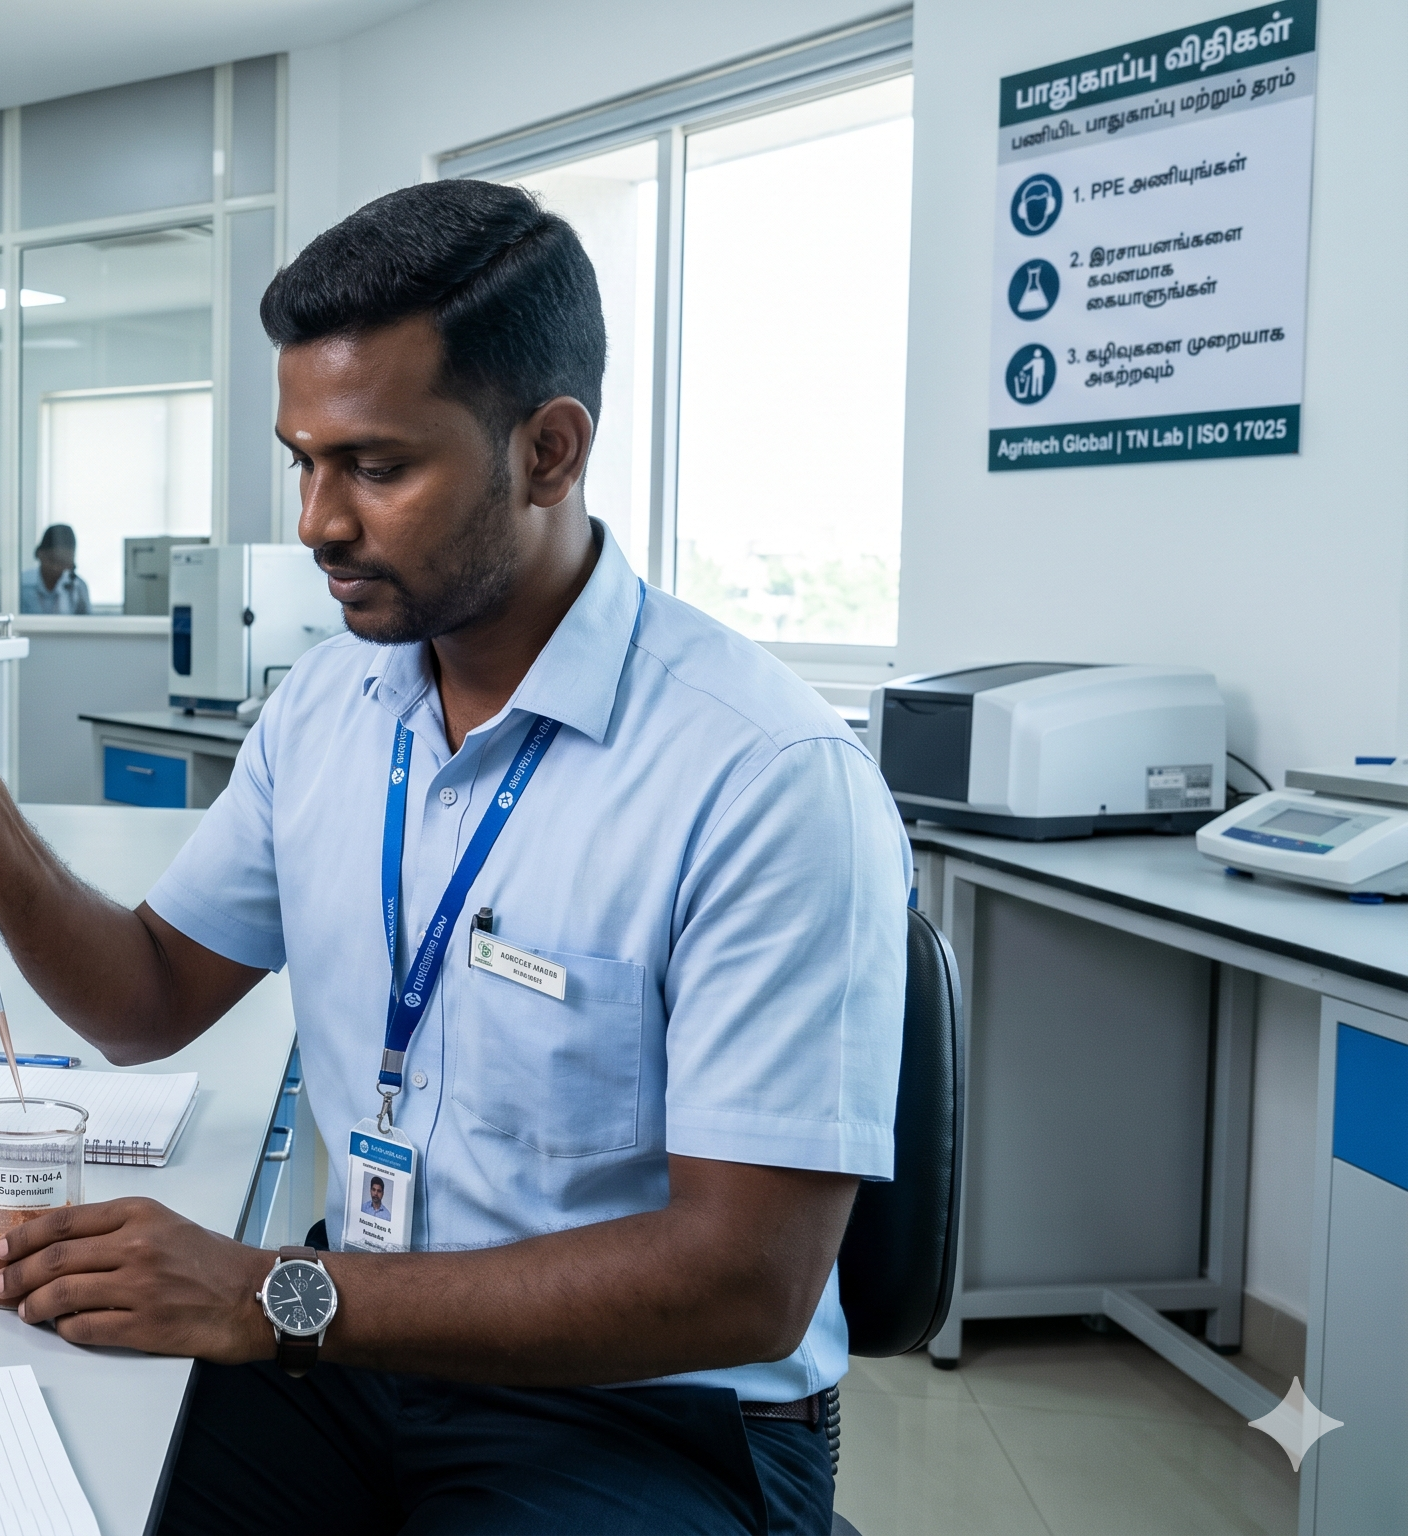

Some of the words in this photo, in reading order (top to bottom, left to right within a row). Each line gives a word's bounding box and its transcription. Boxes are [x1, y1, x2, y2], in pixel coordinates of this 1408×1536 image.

[1016, 52, 1157, 110] பாதுகாப்பு
[1164, 11, 1293, 72] விதிகள்
[1180, 79, 1247, 114] மற்றும்
[1251, 66, 1295, 101] தரம்
[1091, 177, 1125, 200] PPE
[1129, 152, 1247, 194] அணியுங்கள்
[1087, 263, 1174, 288] கவனமாக
[997, 435, 1059, 461] Agritech
[1063, 431, 1113, 453] Global
[1126, 429, 1148, 449] TN
[1153, 426, 1184, 447] Lab
[1197, 422, 1229, 444] ISO
[1233, 418, 1287, 441] 17025
[9, 1174, 22, 1183] ID:
[26, 1171, 62, 1183] TN-04-A
